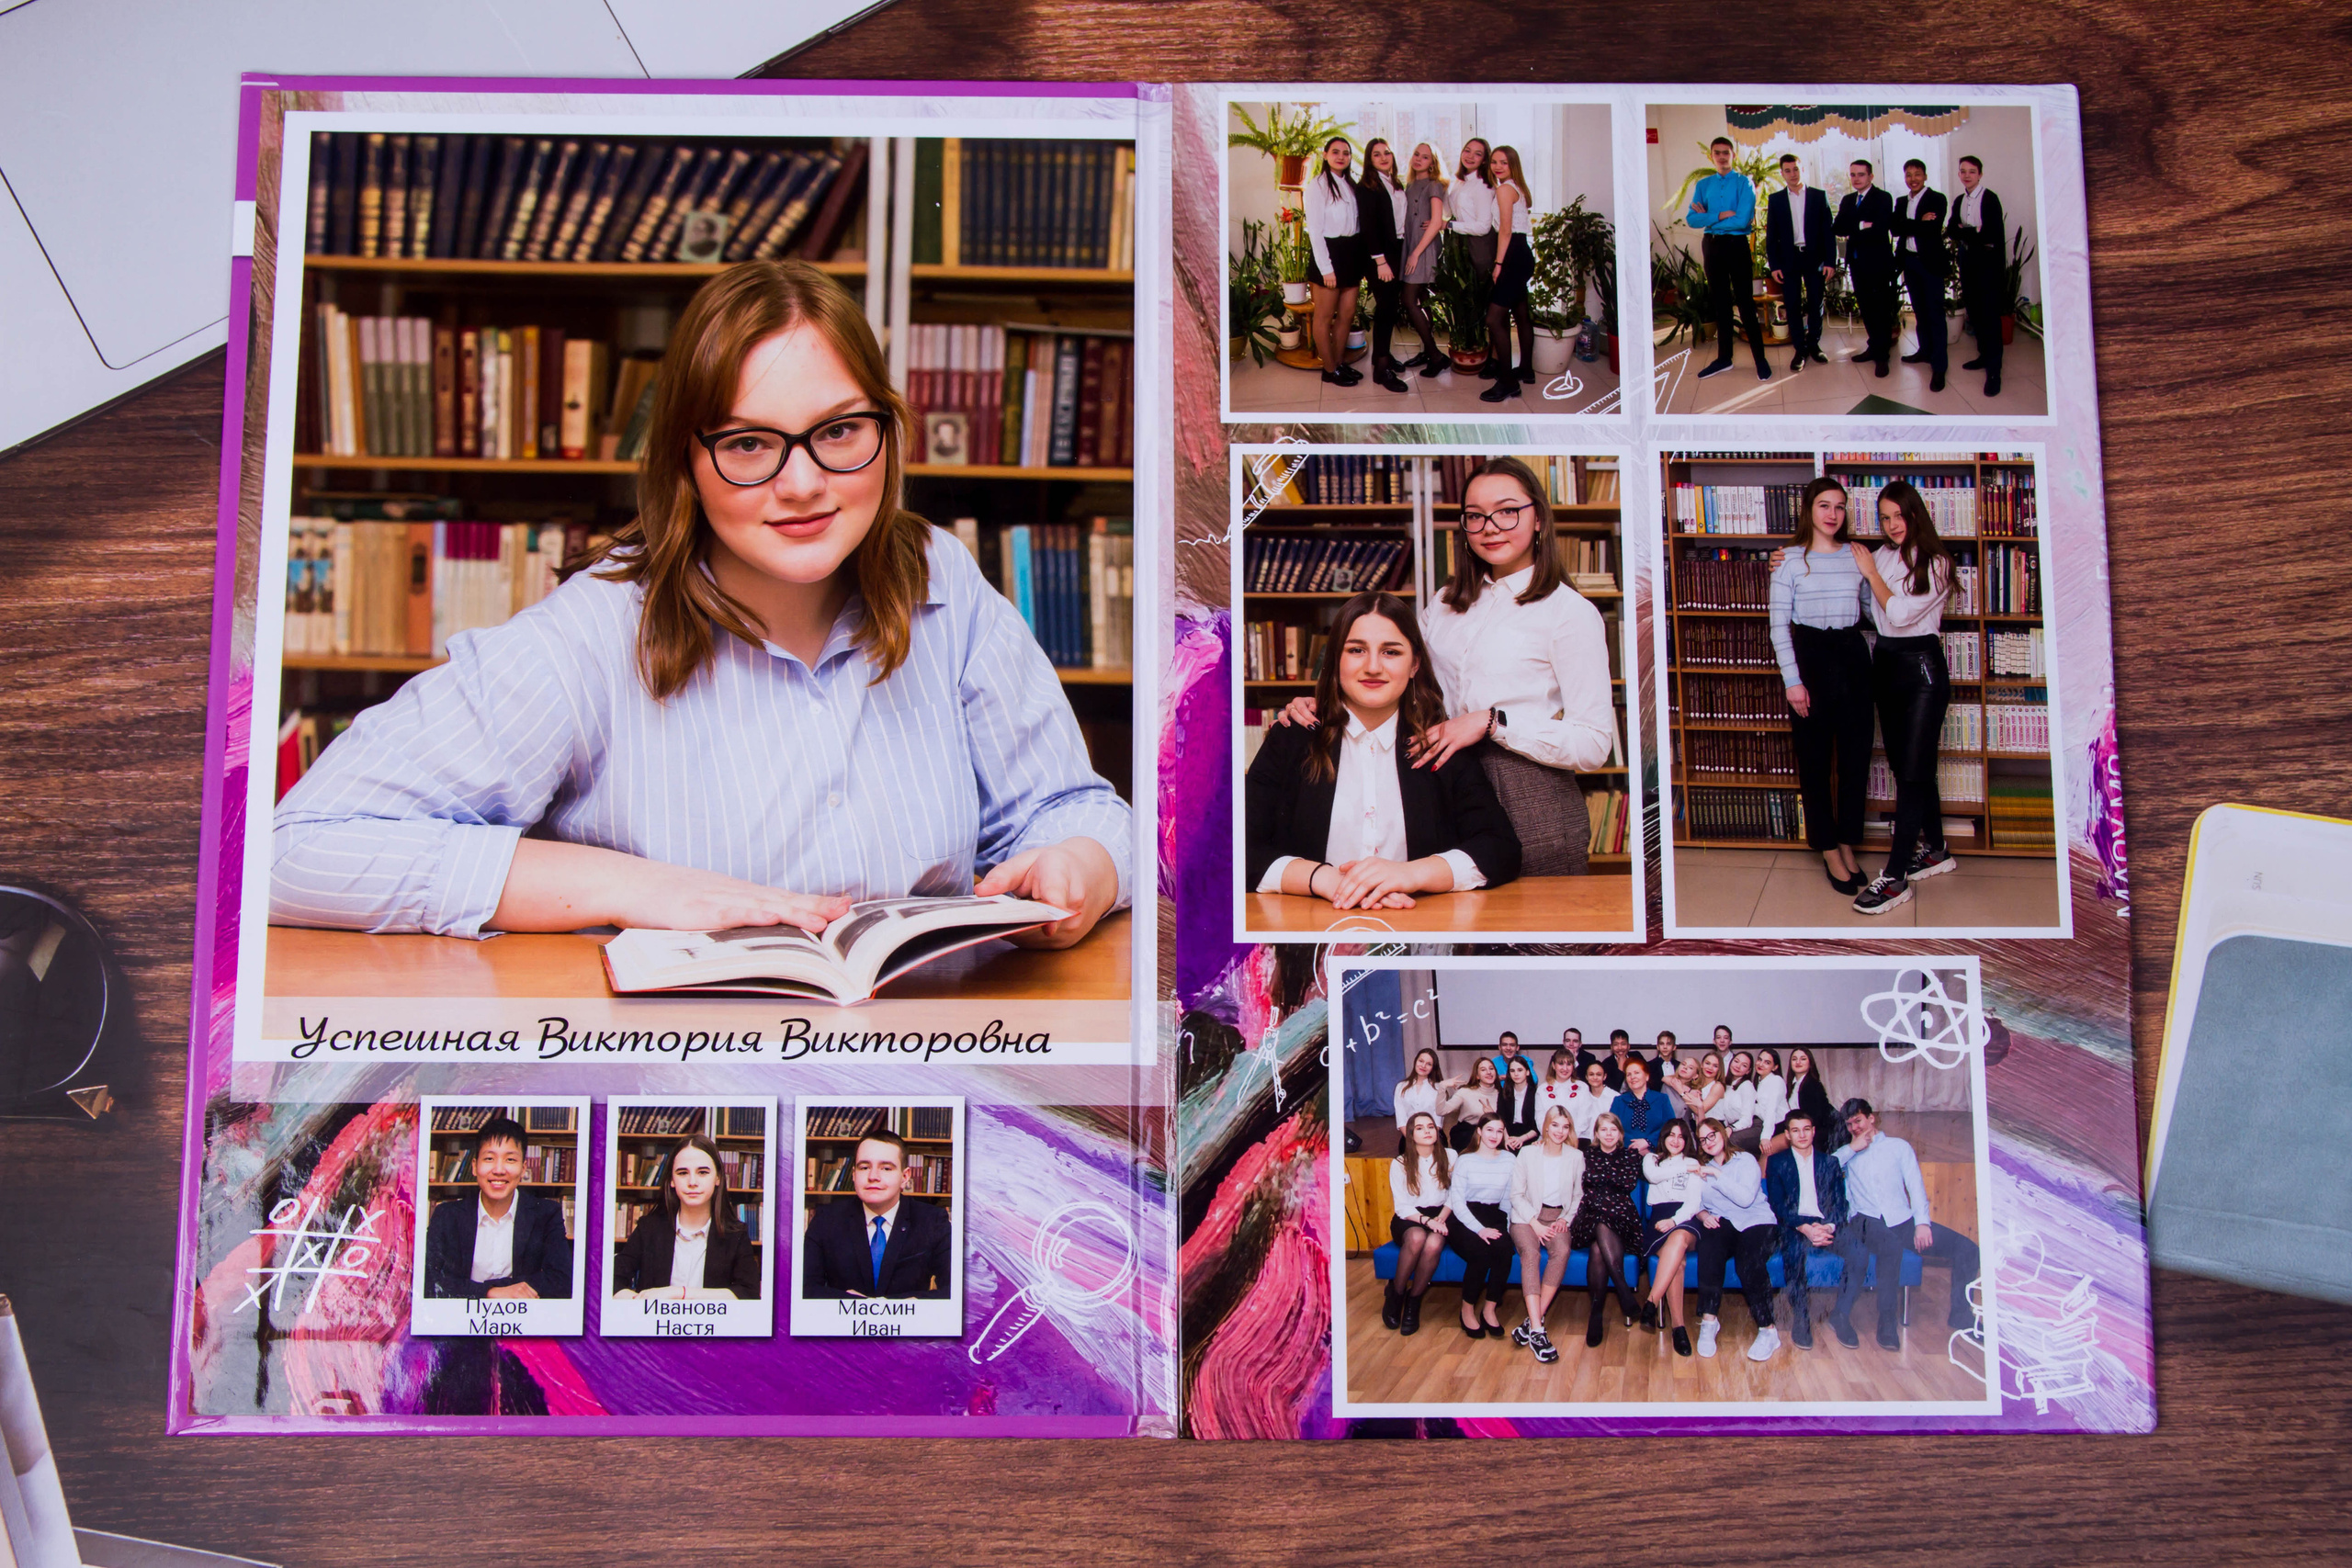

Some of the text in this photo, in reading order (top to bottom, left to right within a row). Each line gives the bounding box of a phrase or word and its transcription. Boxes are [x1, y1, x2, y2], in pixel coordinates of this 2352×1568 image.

[290, 1017, 1052, 1063] Успешная Виктория Викторовна
[466, 1298, 528, 1319] Пудов
[644, 1298, 728, 1315] Иванова
[838, 1299, 916, 1315] Маслин
[469, 1318, 523, 1337] Марк
[655, 1319, 715, 1336] Настя
[852, 1319, 901, 1337] Иван
